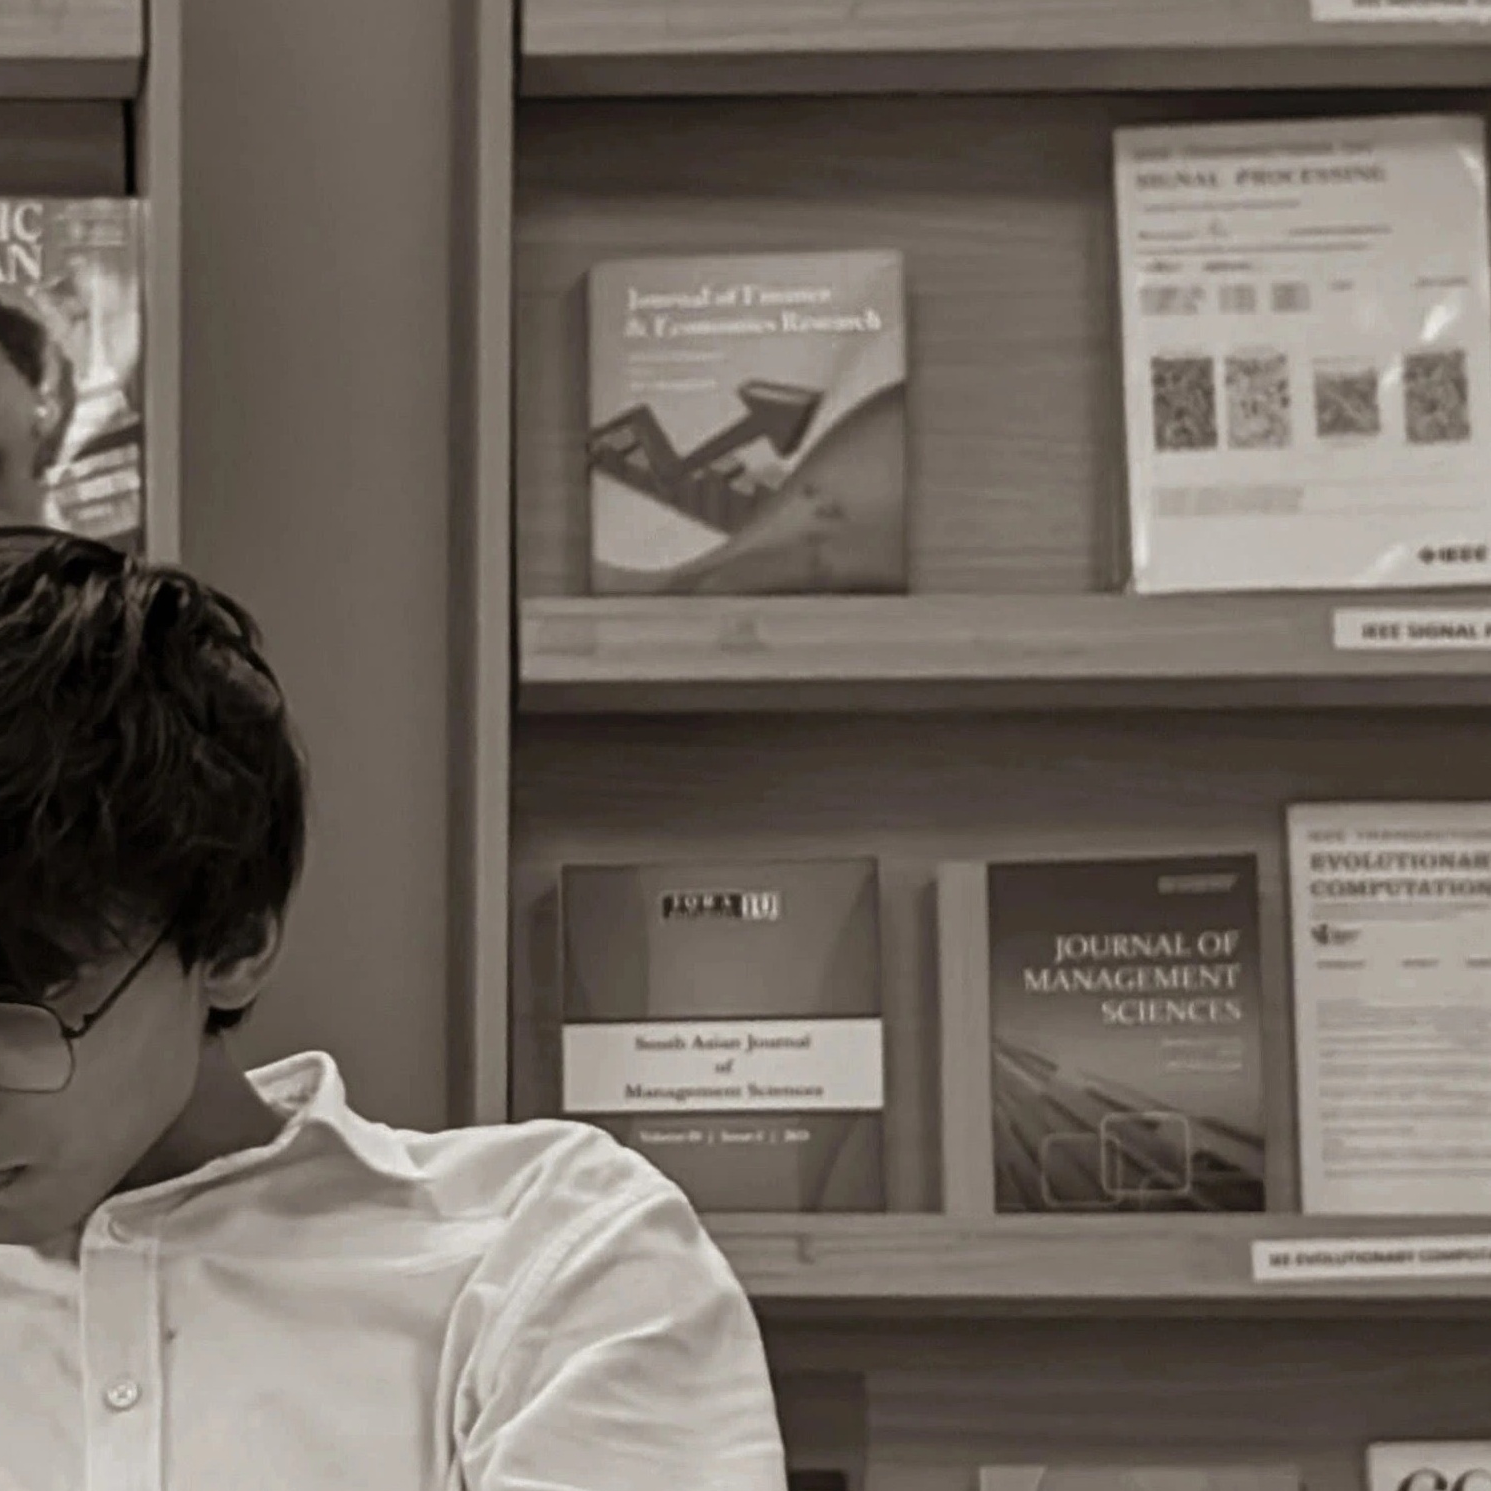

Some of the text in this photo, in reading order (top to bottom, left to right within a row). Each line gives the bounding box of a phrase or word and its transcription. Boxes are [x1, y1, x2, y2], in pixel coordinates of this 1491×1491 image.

[627, 285, 710, 311] Journal
[780, 308, 883, 333] Research
[1362, 622, 1478, 641] IEEE SIGNAL
[1054, 929, 1242, 964] JOURNAL OF
[1023, 963, 1243, 992] MANAGEMENT
[1100, 998, 1243, 1025] SCIENCES
[691, 1034, 741, 1050] Asian
[745, 1034, 812, 1054] Journal
[714, 1058, 735, 1074] of
[623, 1082, 825, 1102] Management Sciences
